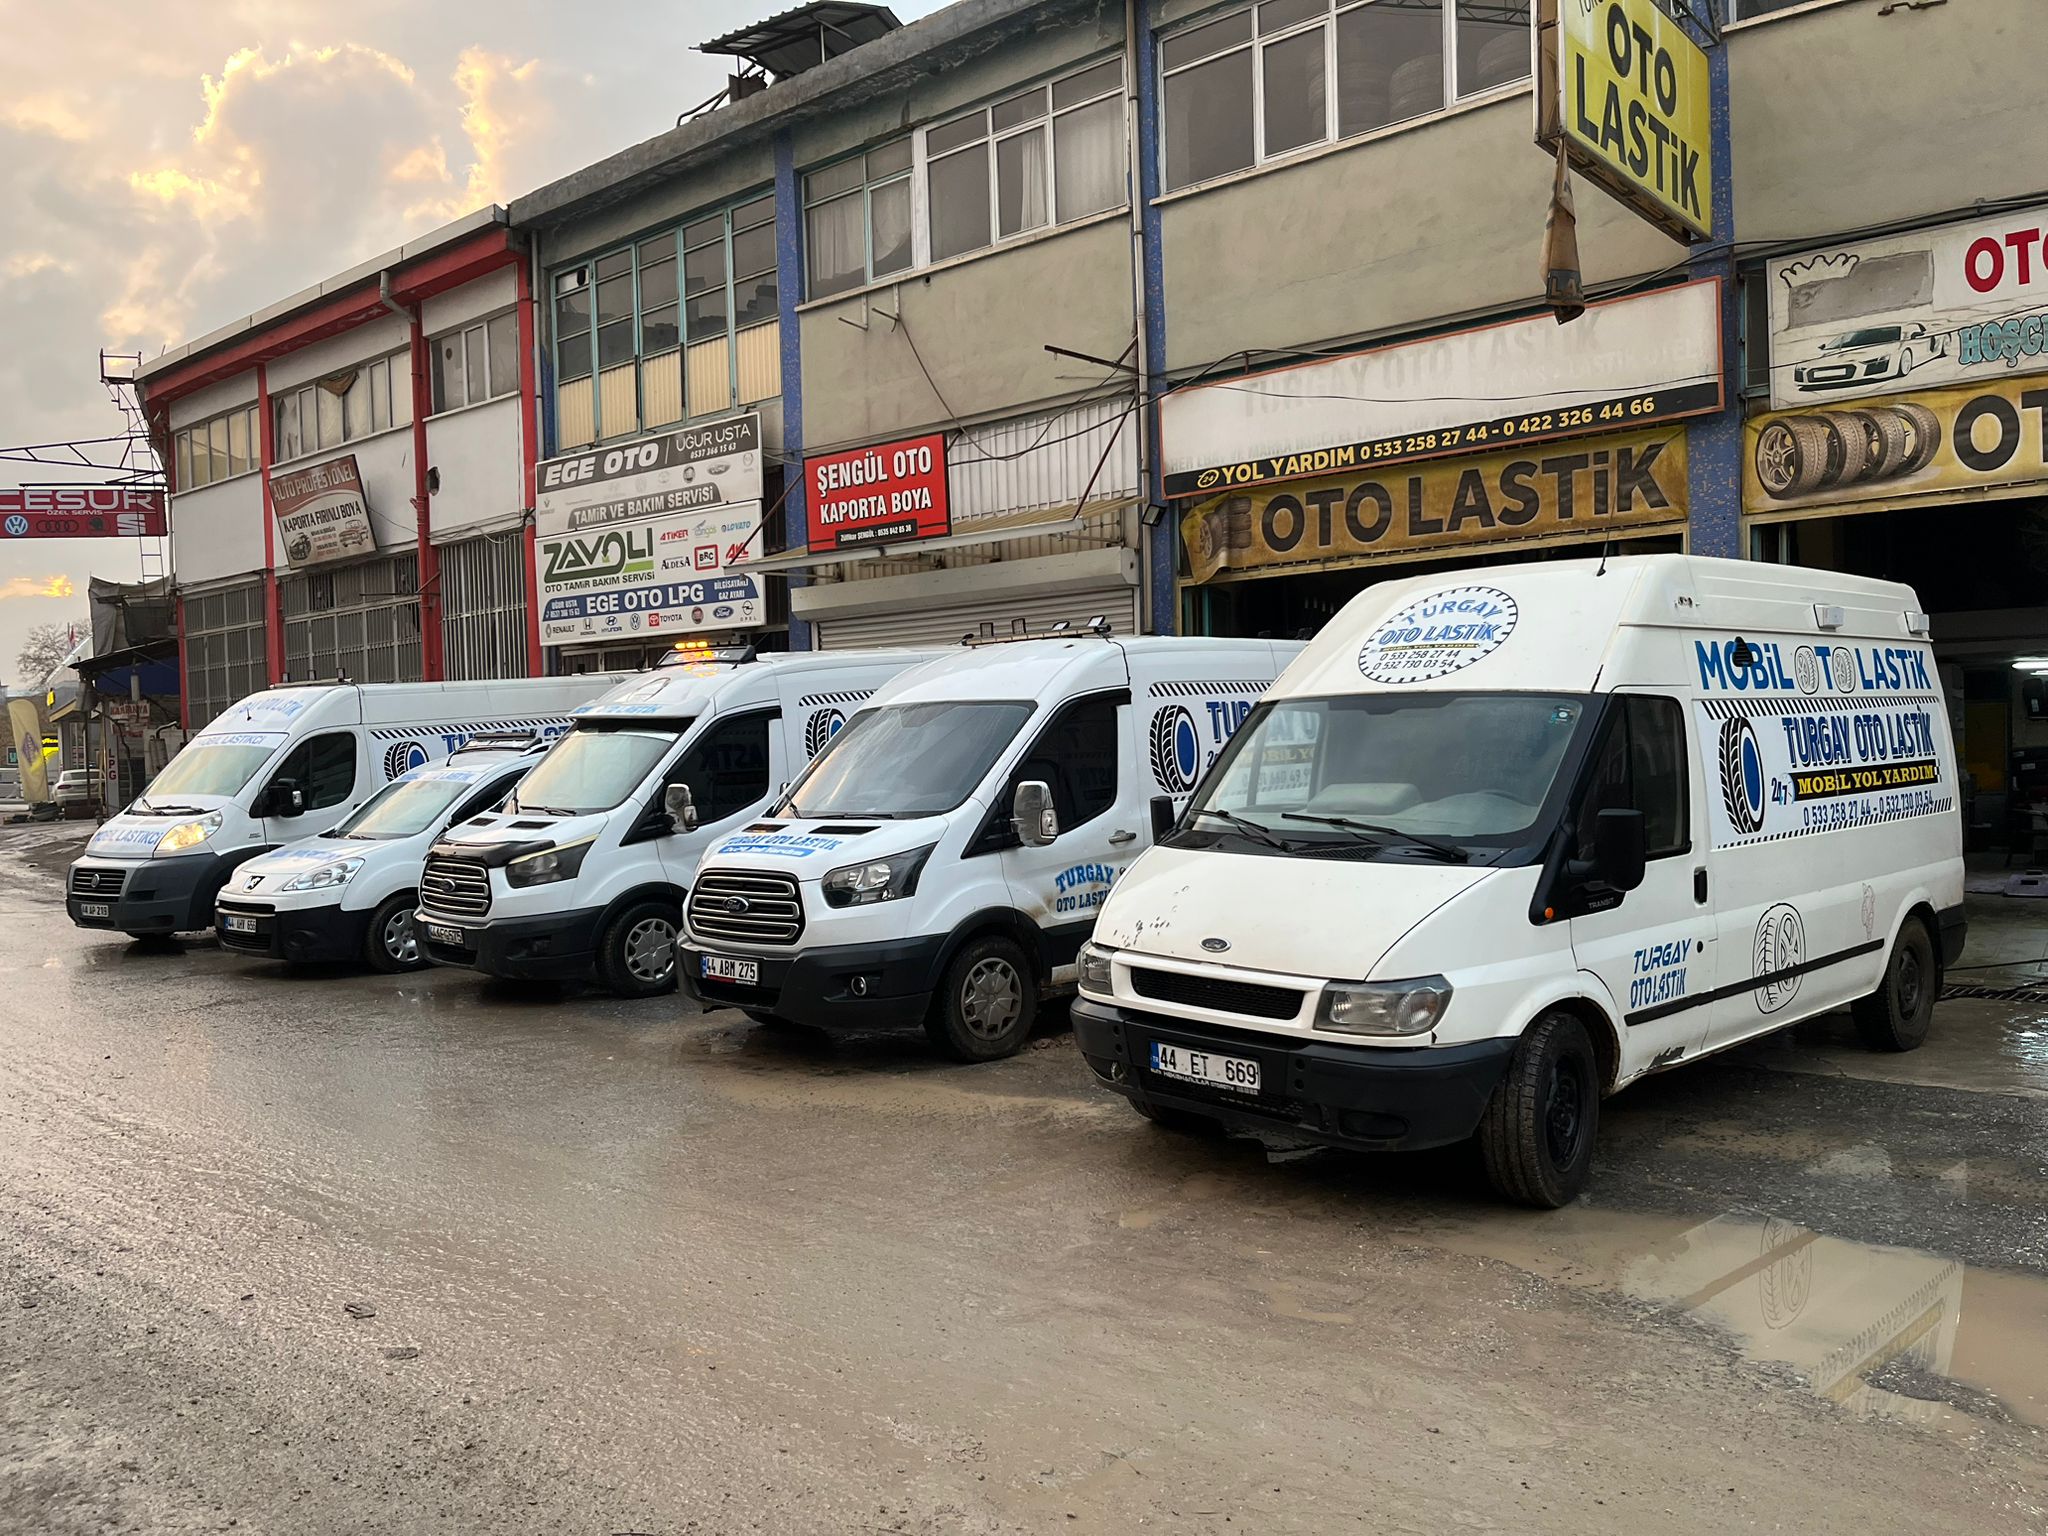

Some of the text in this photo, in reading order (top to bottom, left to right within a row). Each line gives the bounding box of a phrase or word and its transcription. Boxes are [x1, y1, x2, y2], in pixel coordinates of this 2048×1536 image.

[1607, 2, 1677, 117] OTO
[1965, 228, 2048, 292] OT
[676, 423, 751, 451] UĞUR USTA
[1221, 463, 1264, 484] YOL
[1270, 446, 1355, 477] YARDIM
[1360, 448, 1370, 460] 0
[1374, 439, 1402, 458] 533
[1406, 435, 1437, 452] 258
[1441, 430, 1460, 446] 27
[1466, 425, 1488, 441] 44
[1503, 421, 1514, 436] 0
[1519, 416, 1552, 433] 422
[1559, 408, 1593, 427] 326
[1599, 403, 1623, 420] 44
[1630, 397, 1655, 413] 66
[544, 443, 660, 487] EGE OTO
[817, 446, 932, 498] ŞENGÜL OTO
[283, 512, 316, 533] KAPORTA
[341, 500, 362, 518] BOYA
[610, 502, 624, 518] VE
[628, 495, 664, 516] BAKIM
[820, 487, 932, 524] KAPORTA BOYA
[1261, 482, 1392, 553] OTO
[726, 521, 752, 532] LOVATO
[544, 528, 654, 584] ZAVOLI
[699, 551, 714, 561] BRC
[545, 583, 562, 593] OTO
[592, 577, 620, 587] BAKIM
[586, 583, 705, 614] EGE OTO LPG
[660, 614, 683, 622] TOYOTA
[1401, 599, 1503, 625] TURGAY
[553, 625, 575, 634] RENAULT
[1378, 627, 1422, 645] OTO
[1382, 662, 1400, 670] 532
[1402, 660, 1420, 668] 730
[1423, 660, 1438, 668] 03
[1389, 652, 1408, 660] 533
[1408, 651, 1428, 659] 258
[1430, 650, 1445, 658] 27
[1446, 650, 1461, 658] 44
[1782, 715, 1851, 769] TURGAY
[1854, 713, 1887, 762] OTO
[1850, 769, 1882, 789] YOL
[1882, 764, 1935, 785] YARDIM
[1803, 807, 1810, 827] 0
[1812, 805, 1828, 825] 533
[1830, 802, 1846, 823] 258
[1848, 800, 1857, 820] 27
[1879, 796, 1884, 815] 0
[1055, 862, 1114, 893] TURGAY
[1056, 896, 1076, 912] OTO
[1588, 897, 1614, 909] TRANSIT
[720, 960, 735, 976] ABM
[739, 963, 755, 979] 275
[1634, 938, 1691, 974] TURGAY
[1161, 1047, 1176, 1070] 44
[1190, 1053, 1208, 1077] ET
[1225, 1060, 1257, 1085] 669
